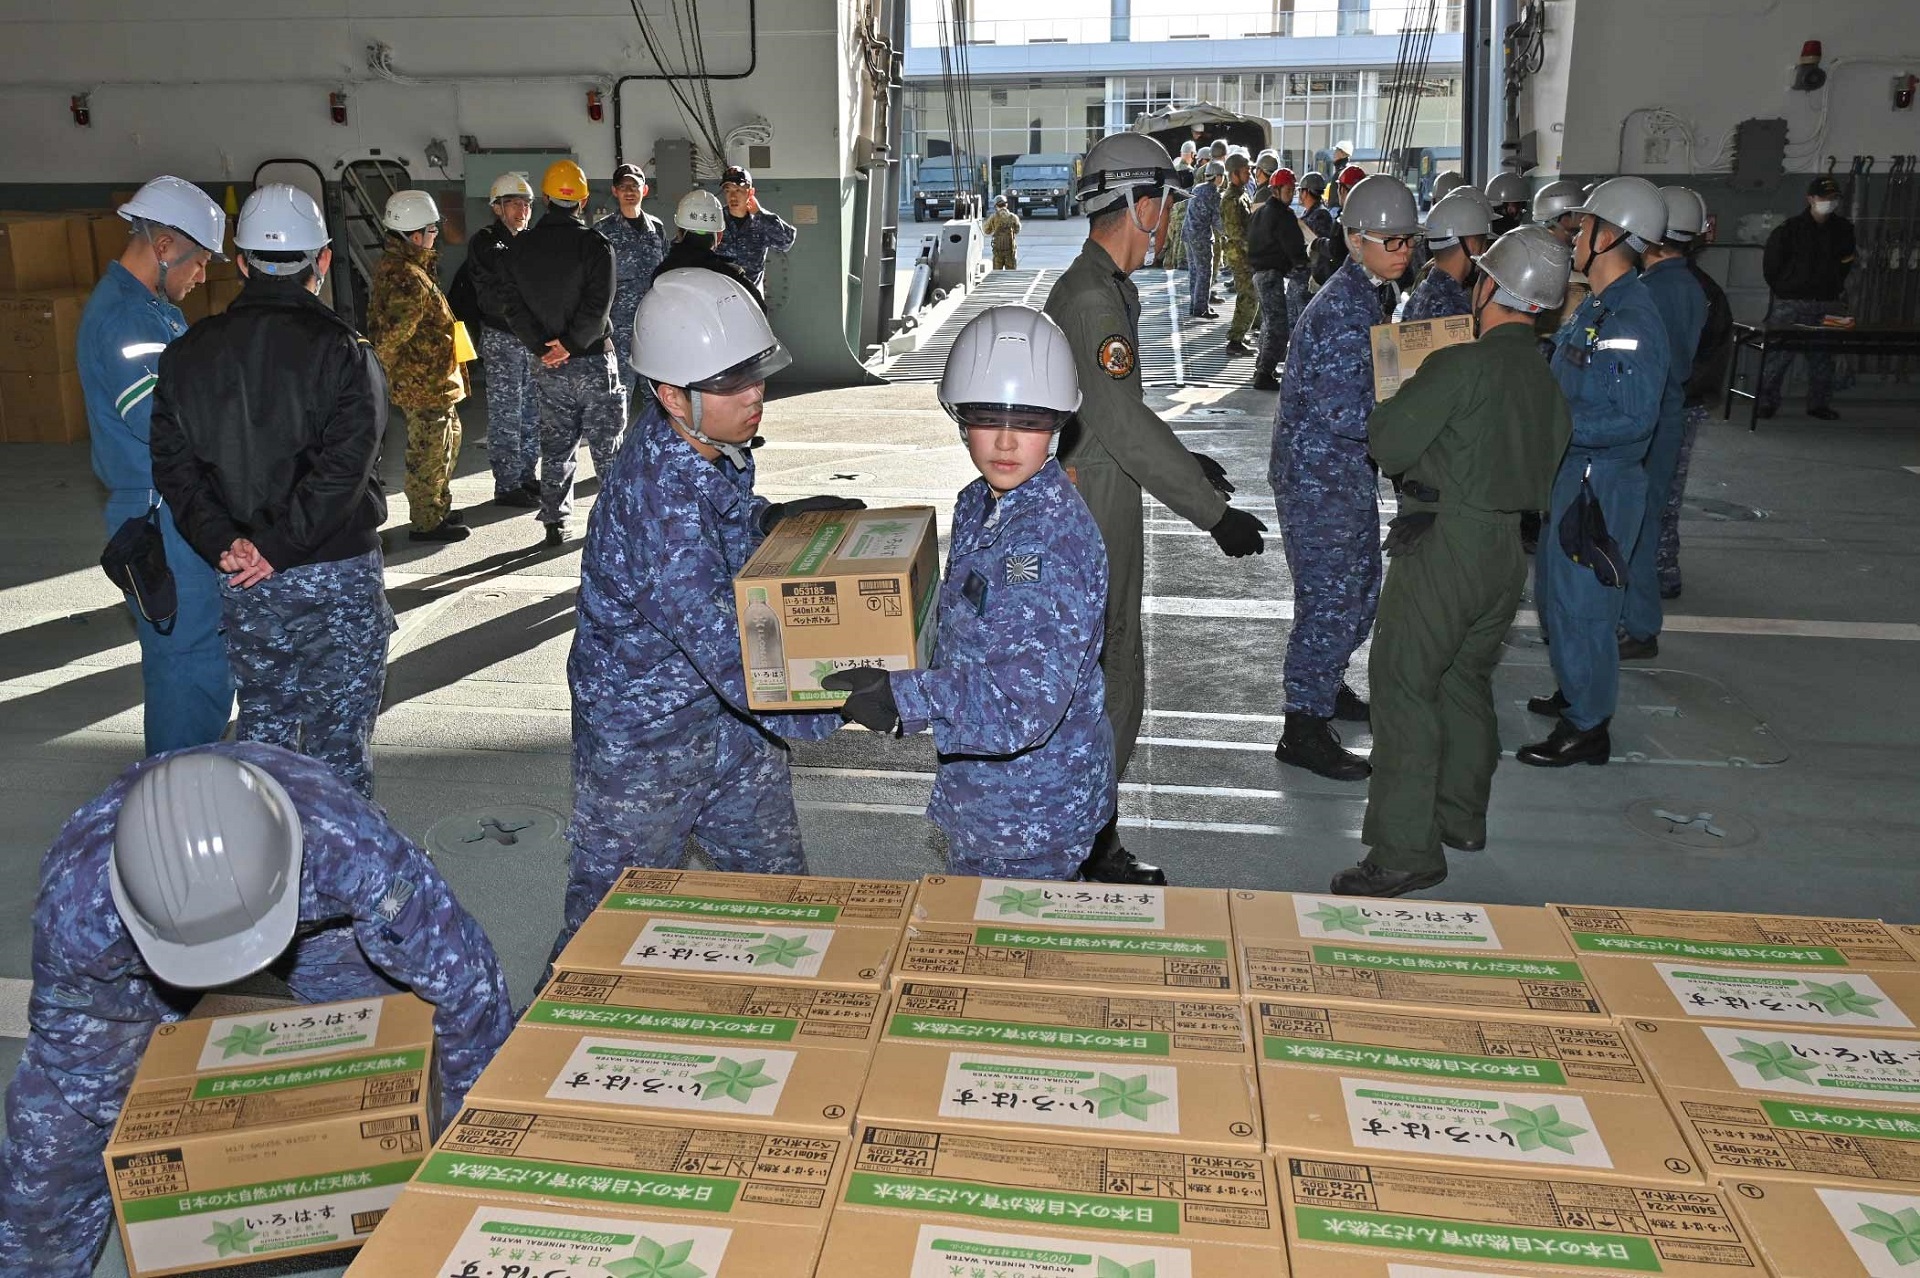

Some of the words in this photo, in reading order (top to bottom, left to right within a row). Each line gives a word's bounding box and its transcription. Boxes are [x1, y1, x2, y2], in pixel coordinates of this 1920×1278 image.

[793, 586, 825, 595] 053185
[792, 606, 831, 615] 540ml×24
[793, 616, 832, 624] ペットボトル
[1044, 890, 1155, 905] い・ろ・は・す
[624, 897, 820, 918] 日本の大自然が育んだ天然水
[1361, 907, 1478, 924] い・ろ・は・す
[994, 933, 1208, 954] 日本の大自然が育んだ天然水
[1595, 938, 1823, 961] 日本の大自然が育んだ天然水
[637, 945, 754, 964] い・ろ・は・す
[1333, 951, 1561, 976] 日本の大自然が育んだ天然水
[1689, 992, 1825, 1013] い・ろ・は・す
[270, 1008, 374, 1032] い・ろ・は・す
[551, 1007, 776, 1034] 日本の大自然が育んだ天然水
[1181, 1011, 1235, 1020] 540ml×24
[912, 1021, 1147, 1049] 日本の大自然が育んだ天然水
[1559, 1036, 1618, 1047] 540ml×24
[1286, 1045, 1541, 1077] 日本の大自然が育んだ天然水
[211, 1057, 408, 1092] 日本の大自然が育んだ天然水
[595, 1063, 689, 1078] 日本の天然水
[1825, 1063, 1920, 1076] 日本の天然
[565, 1072, 702, 1096] い・ろ・は・す
[1004, 1074, 1040, 1082] MINERAL
[975, 1079, 1074, 1095] 日本の天然水
[952, 1088, 1095, 1114] い・ろ・は・す
[1404, 1102, 1443, 1110] MINERAL
[1377, 1107, 1485, 1126] 日本の天然水
[1446, 1107, 1487, 1115] NATURAL
[1790, 1109, 1920, 1133] 日本の大自然
[486, 1129, 518, 1139] してね
[1362, 1118, 1515, 1147] い・ろ・は・す
[455, 1134, 513, 1147] リサイクル
[771, 1137, 831, 1149] ペットボトル
[768, 1148, 828, 1160] 540ml×24
[896, 1149, 929, 1159] してね
[1713, 1143, 1780, 1157] 540ml×24
[128, 1154, 169, 1167] 053185
[867, 1154, 927, 1167] リサイクル
[1191, 1157, 1255, 1169] ペットボトル
[1720, 1154, 1787, 1168] ペットボトル
[117, 1165, 157, 1179] い・ろ・は・す
[1192, 1167, 1256, 1180] 540ml×24
[127, 1173, 177, 1187] 540ml×24
[448, 1162, 713, 1201] 日本の大自然が育んだ天然水
[128, 1184, 179, 1196] ペットボトル
[178, 1171, 373, 1211] 日本の大自然が育んだ天然水
[1216, 1184, 1262, 1197] い・ろ・は・す
[1303, 1187, 1368, 1201] リサイクル
[1330, 1182, 1365, 1193] してね
[873, 1183, 1153, 1223] 日本の大自然が育んだ天然水
[1641, 1191, 1711, 1203] ペットボトル
[1648, 1201, 1717, 1215] 540ml×24
[246, 1205, 336, 1230] い・ろ・は・す
[1681, 1221, 1731, 1234] い・ろ・は・す
[490, 1235, 522, 1245] WATER
[526, 1239, 567, 1249] MINERAL
[579, 1232, 617, 1244] 100%
[1323, 1217, 1630, 1260] 日本の大自然が育んだ天然水
[570, 1243, 612, 1253] NATURAL
[488, 1246, 602, 1267] 日本の天然水
[945, 1254, 979, 1264] WATER
[983, 1258, 1026, 1269] MINERAL
[1036, 1251, 1072, 1265] 100%
[1031, 1263, 1074, 1273] NATURAL
